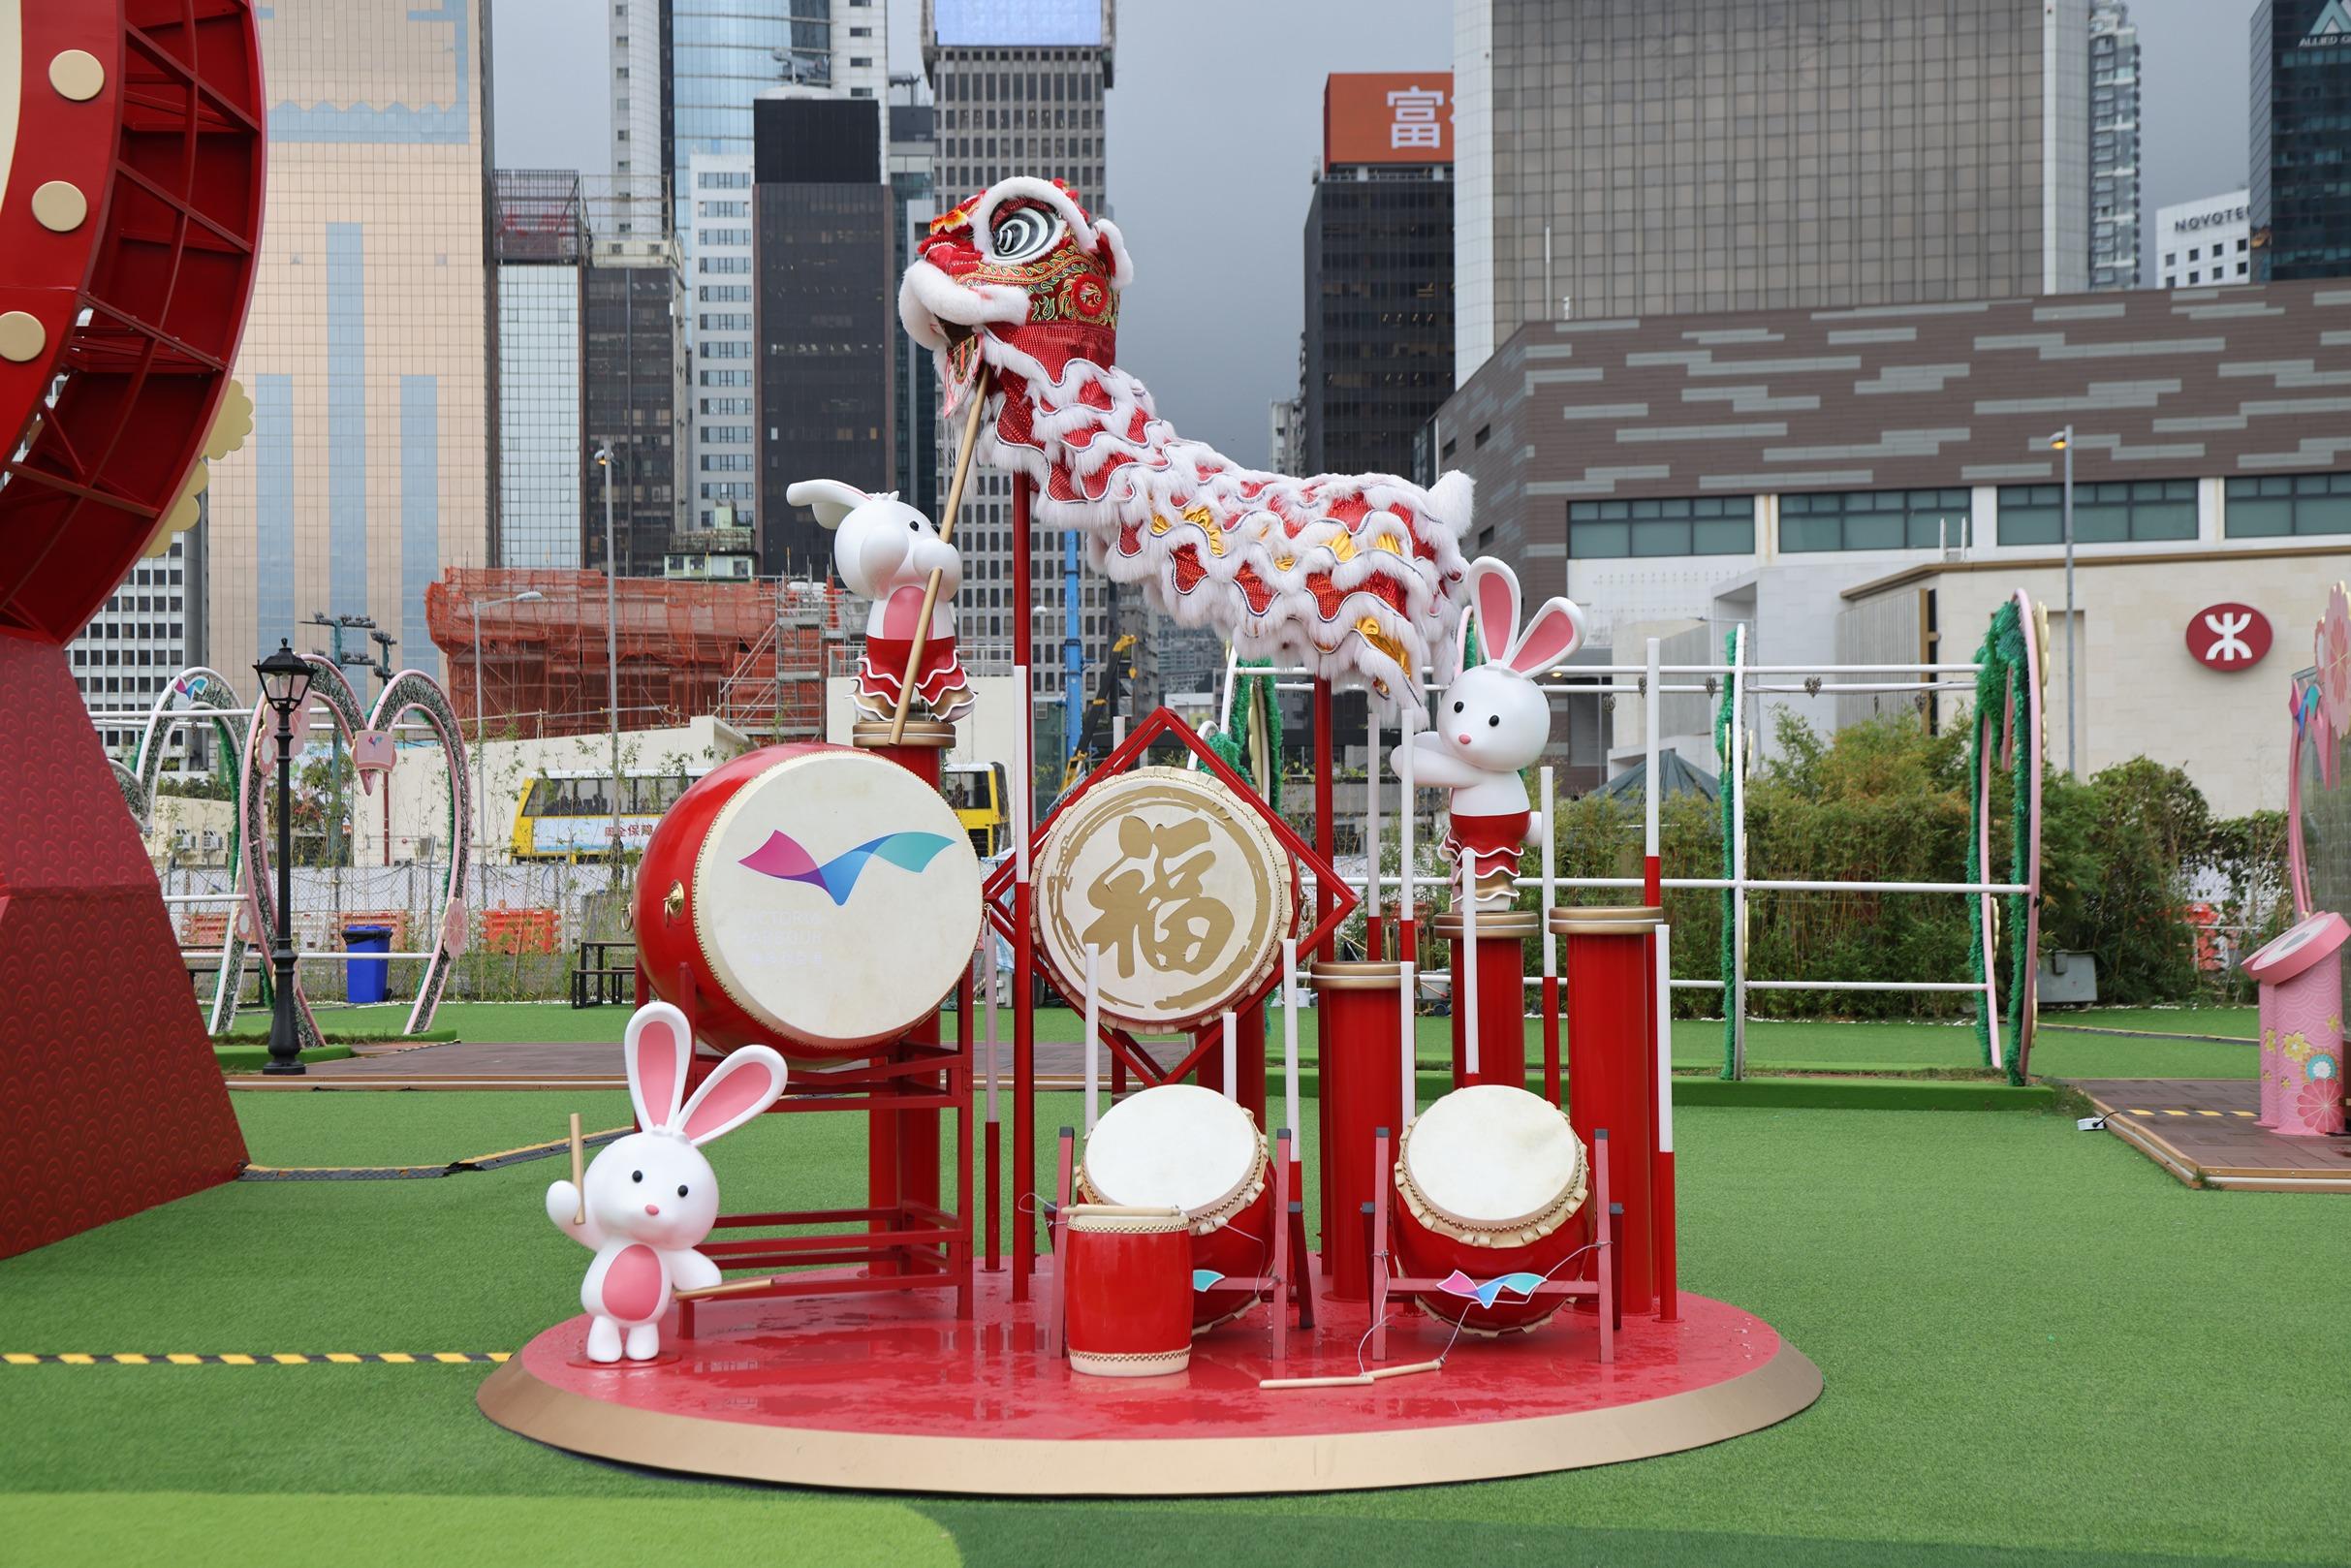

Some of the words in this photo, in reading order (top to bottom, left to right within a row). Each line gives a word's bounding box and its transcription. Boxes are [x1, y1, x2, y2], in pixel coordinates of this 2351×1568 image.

[2298, 36, 2338, 47] ALLIED
[1387, 85, 1454, 149] 富
[1081, 815, 1236, 979] 福
